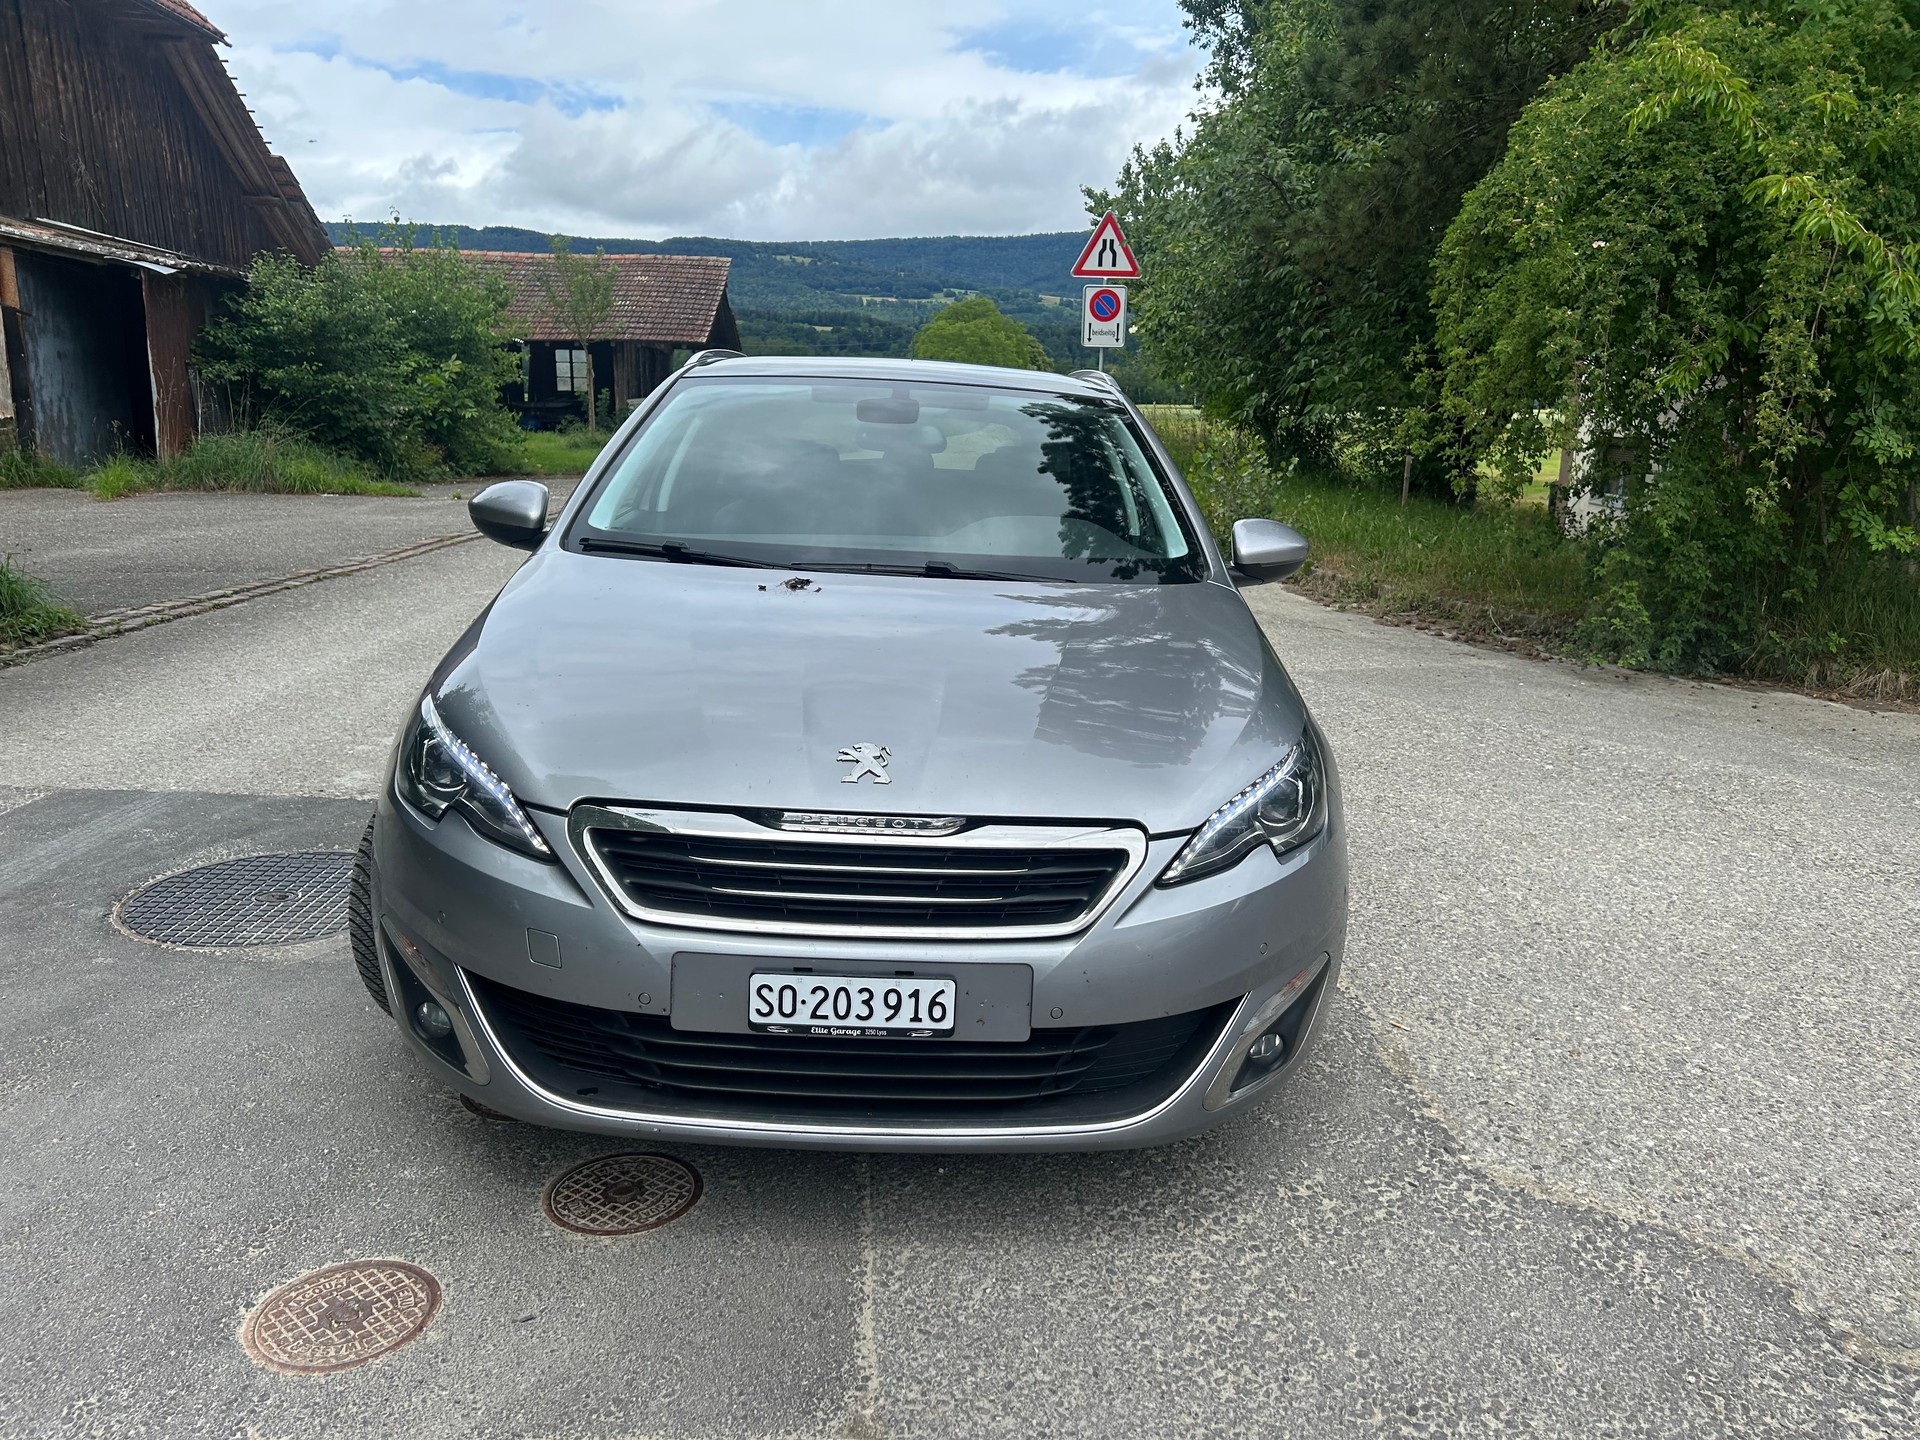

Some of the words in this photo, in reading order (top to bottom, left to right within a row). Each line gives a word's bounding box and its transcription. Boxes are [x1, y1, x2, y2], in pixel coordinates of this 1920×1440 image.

[1092, 328, 1115, 338] beidseitig
[801, 815, 924, 829] PEUGEOT
[810, 1026, 828, 1034] Elite
[830, 1027, 861, 1036] Garage
[394, 1287, 415, 1308] EAU
